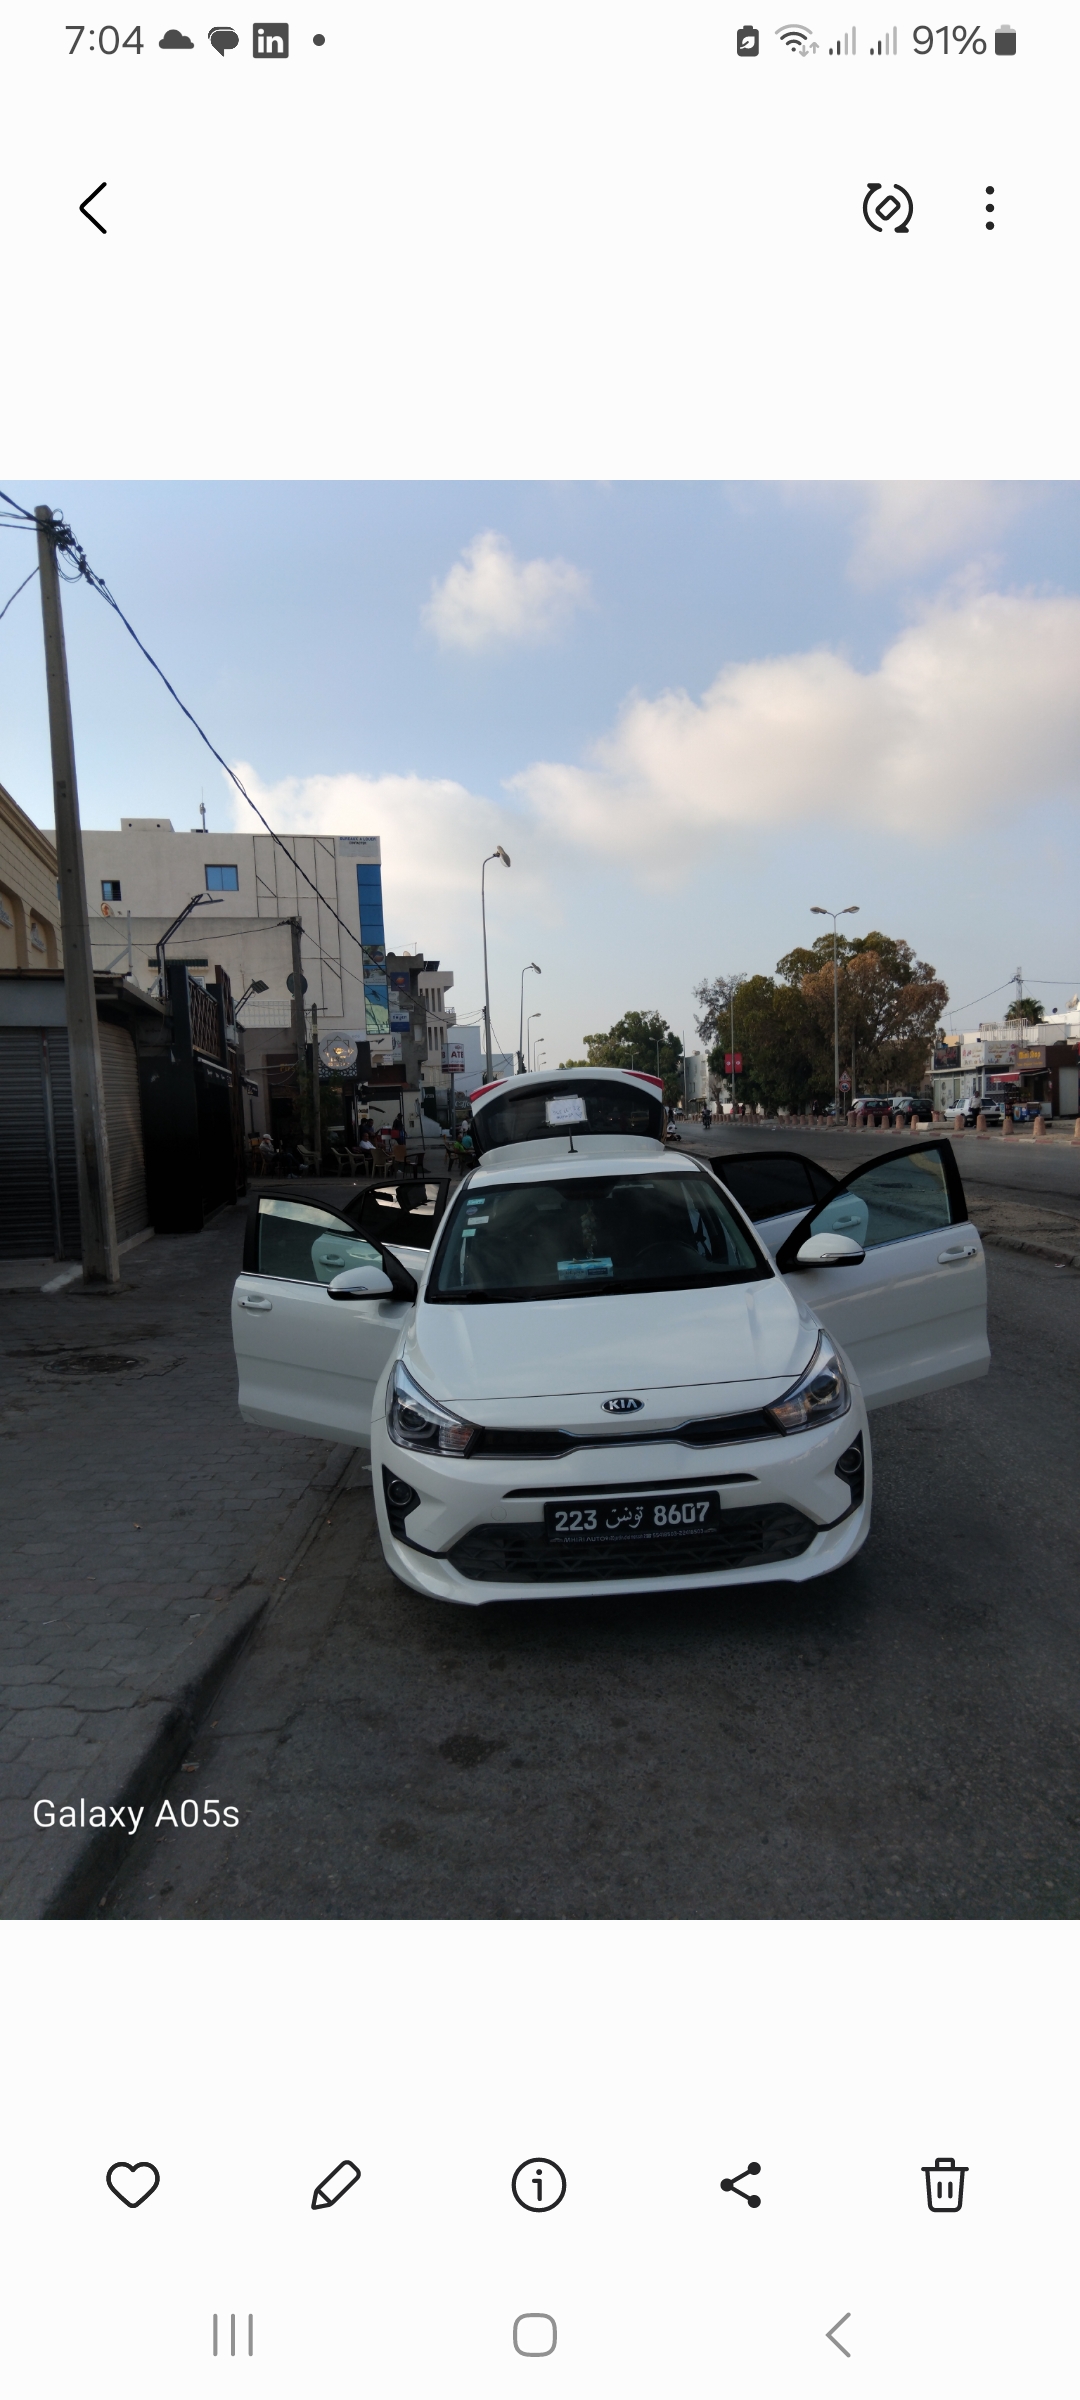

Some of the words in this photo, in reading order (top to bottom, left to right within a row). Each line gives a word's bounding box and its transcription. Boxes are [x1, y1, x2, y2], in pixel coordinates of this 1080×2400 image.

[609, 1399, 638, 1410] KIA
[555, 1510, 597, 1531] 223
[606, 1506, 643, 1529] تونس
[653, 1502, 710, 1526] 8607
